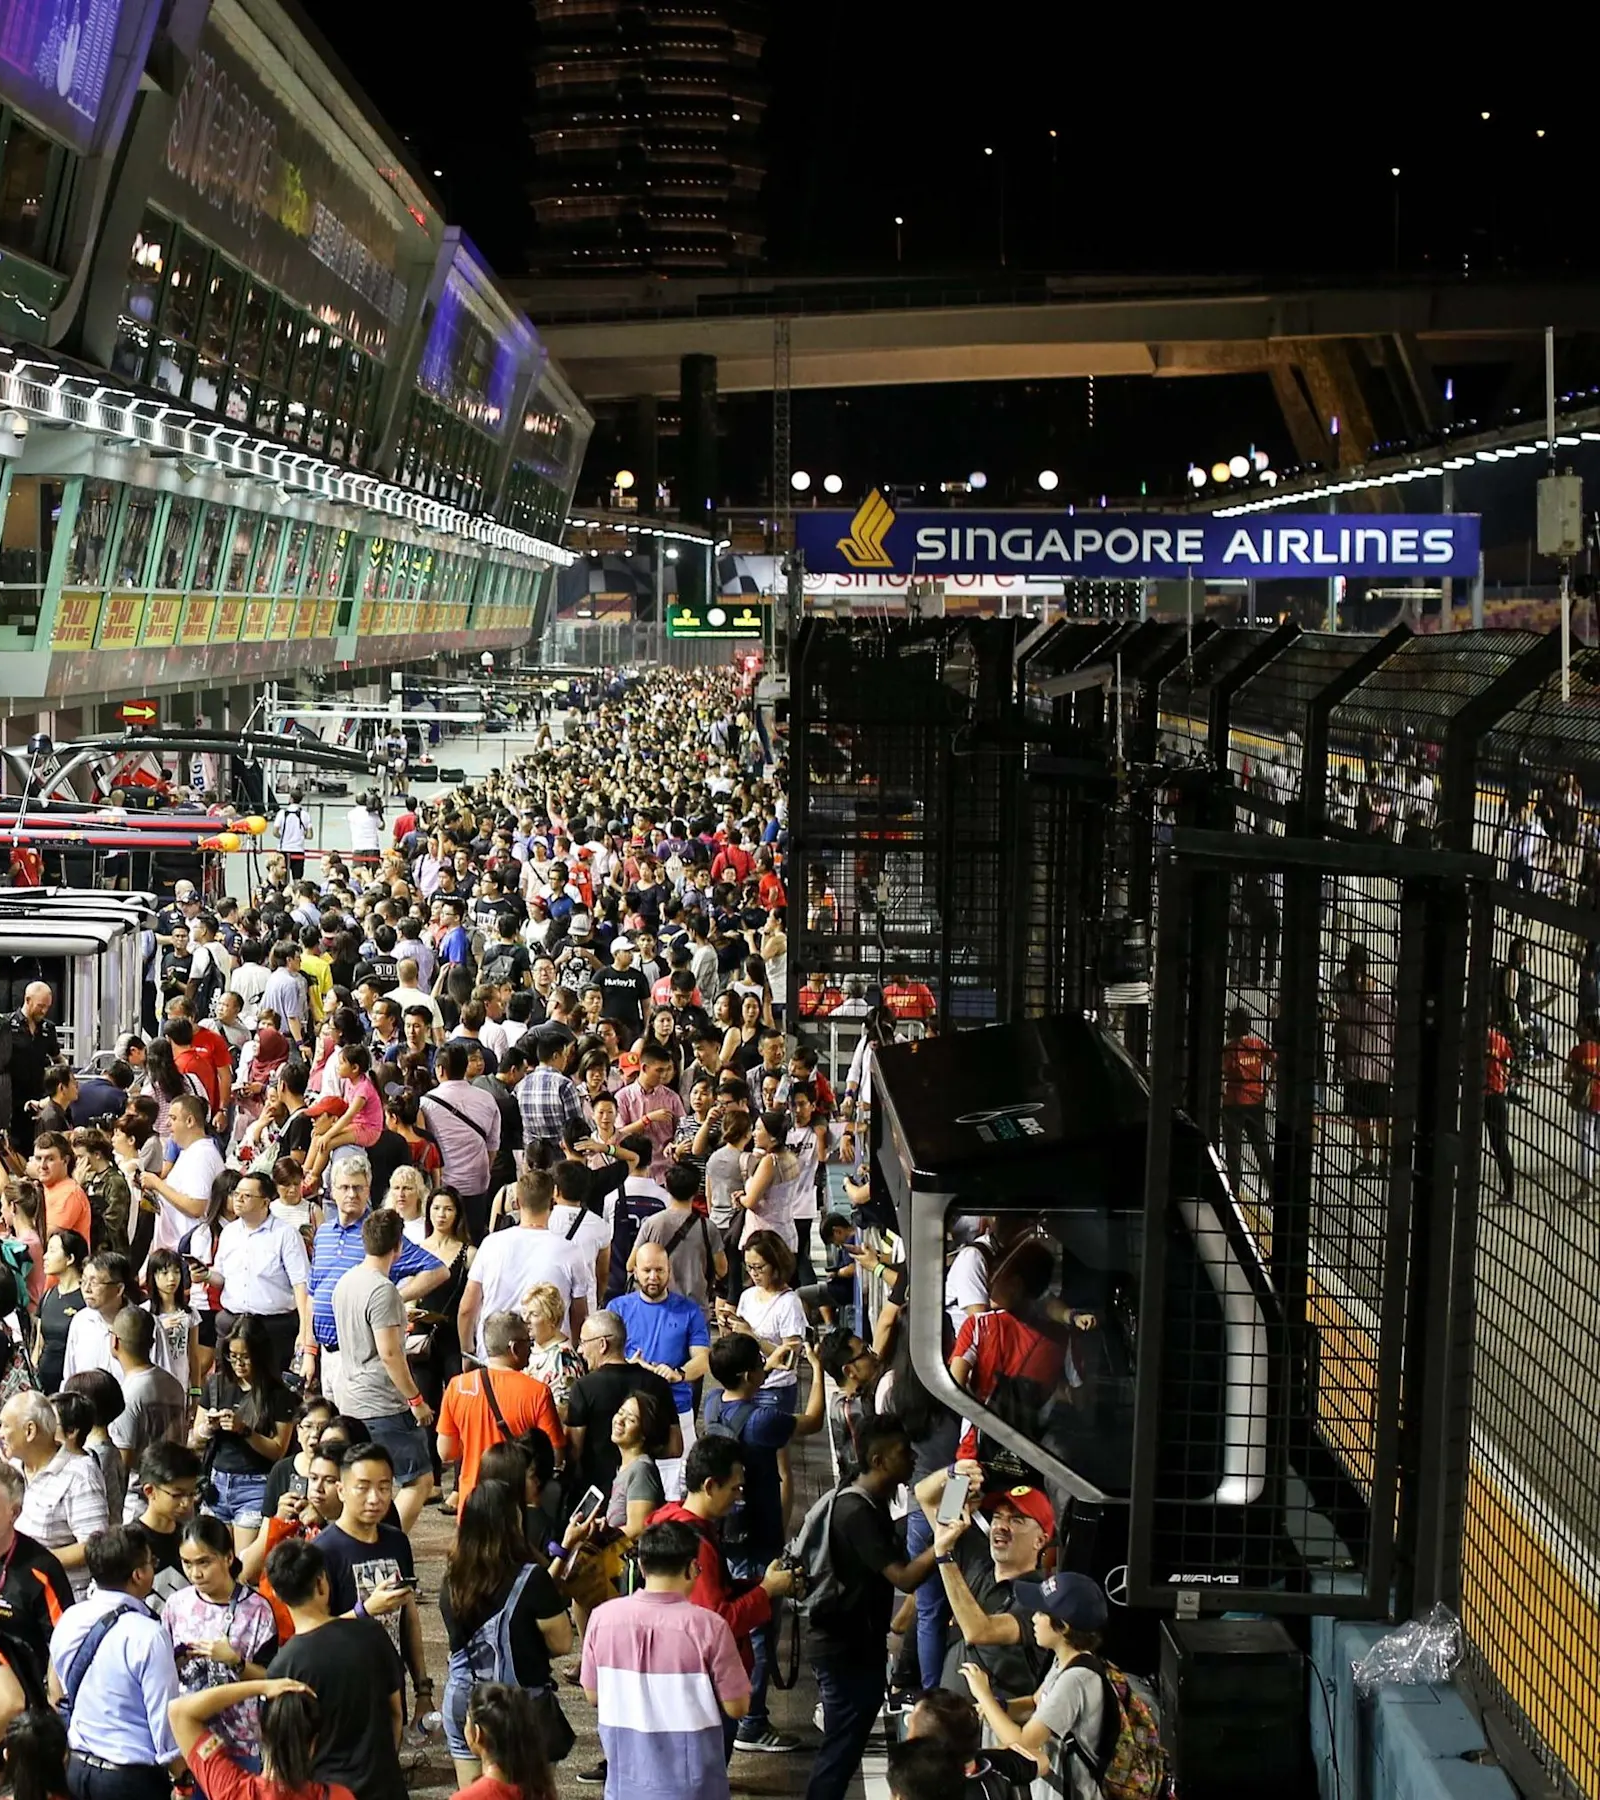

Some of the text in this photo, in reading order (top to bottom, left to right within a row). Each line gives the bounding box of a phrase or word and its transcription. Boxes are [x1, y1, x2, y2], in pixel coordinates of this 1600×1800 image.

[916, 527, 1454, 563] SINGAPORE AIRLINES
[55, 600, 90, 641] DHL
[103, 601, 136, 639] DHL
[147, 601, 174, 637] DHL
[1186, 1574, 1239, 1583] AMG
